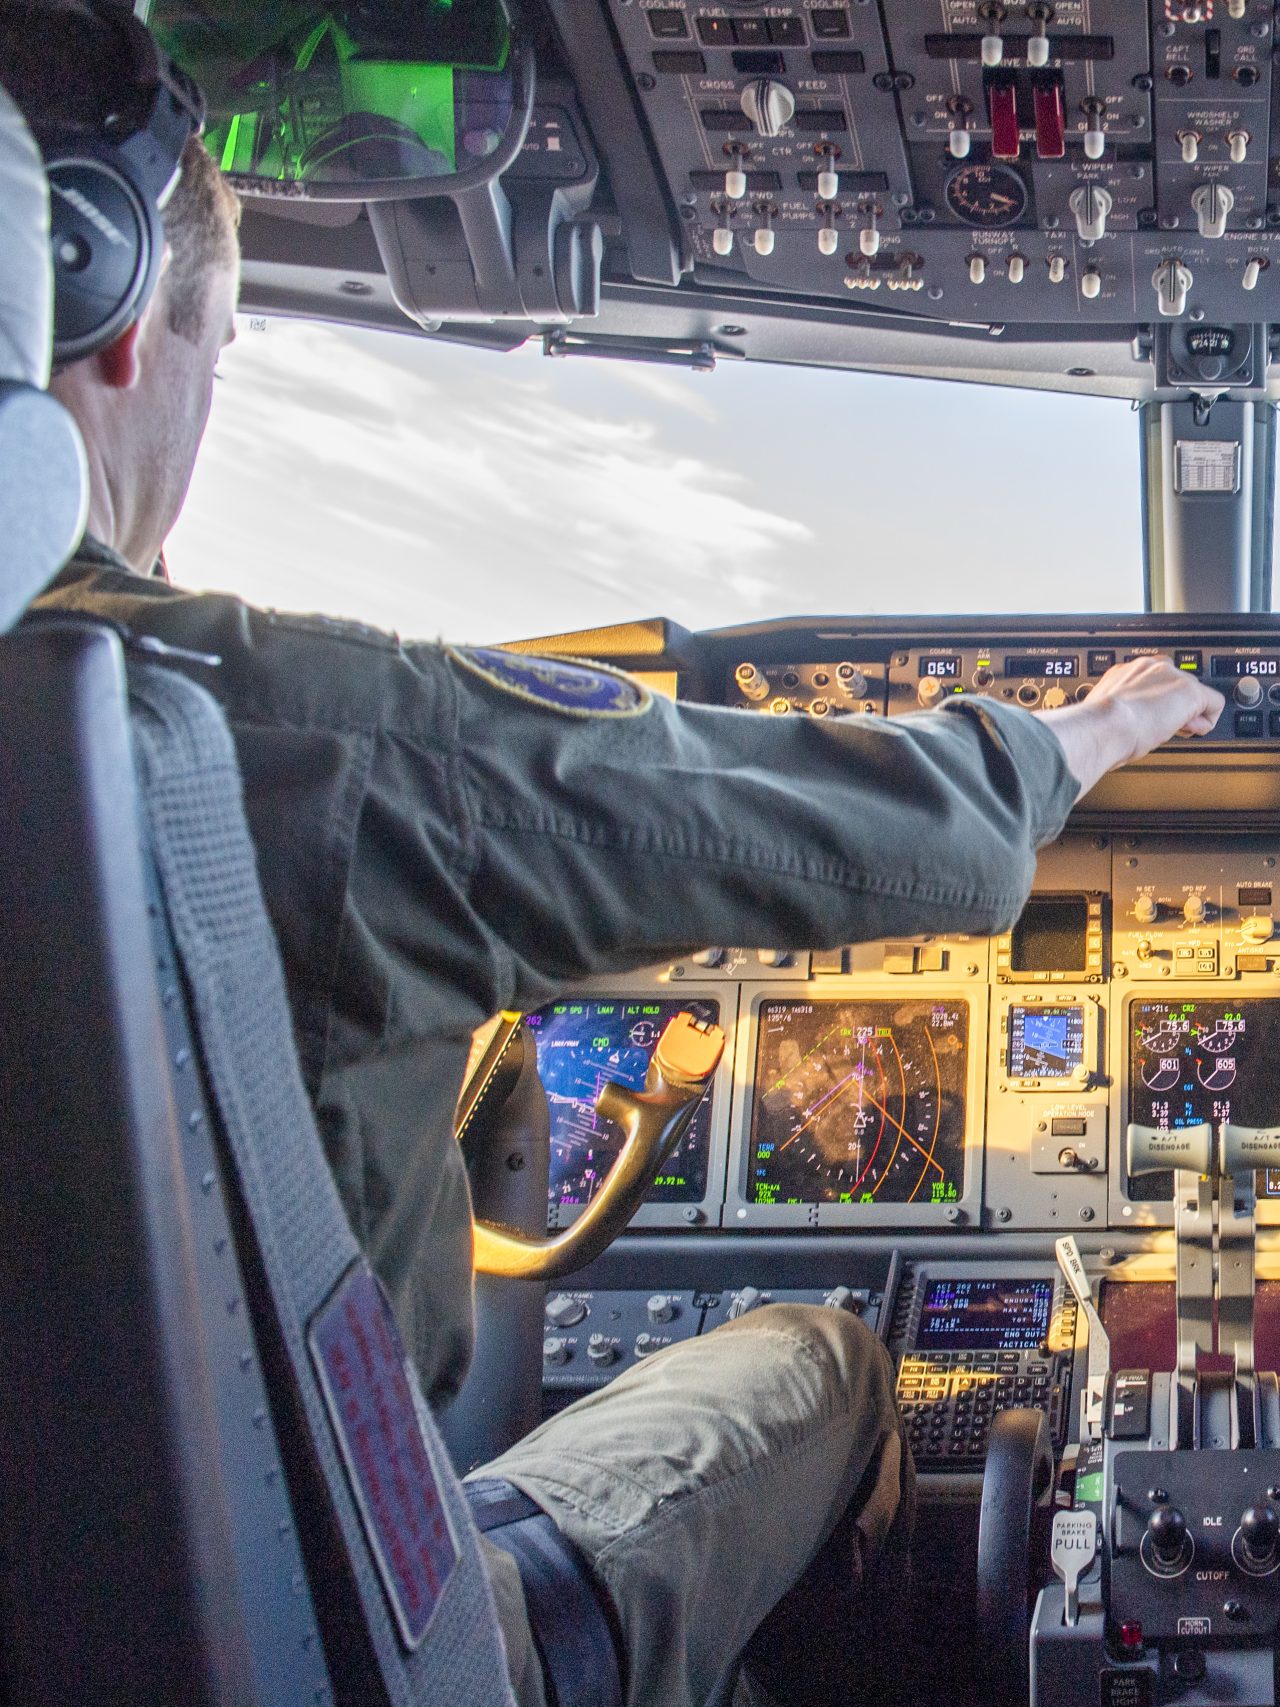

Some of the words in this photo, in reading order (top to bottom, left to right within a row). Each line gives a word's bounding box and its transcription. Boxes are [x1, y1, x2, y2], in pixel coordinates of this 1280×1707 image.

[699, 8, 728, 17] FUEL
[763, 8, 793, 17] TEMP
[952, 17, 978, 25] AUTO
[1056, 17, 1083, 25] AUTO
[1165, 45, 1191, 53] CAPT
[1233, 54, 1258, 62] CALL
[699, 81, 735, 90] CROSS
[798, 81, 827, 90] FEED
[925, 94, 944, 102] OFF
[1186, 111, 1240, 119] WINDSHIELD
[771, 148, 793, 156] CTR
[1081, 163, 1114, 171] WIPER
[927, 662, 956, 675] 064
[1045, 662, 1073, 675] 262
[1236, 661, 1278, 674] 11500
[569, 1006, 583, 1014] SPD
[597, 1006, 614, 1014] LNAV
[627, 1006, 640, 1014] ALT
[642, 1006, 660, 1014] HOLD
[1168, 1013, 1186, 1021] 92.0
[1224, 1013, 1241, 1021] 92.0
[1166, 1021, 1189, 1031] 75.6
[1222, 1021, 1244, 1031] 75.6
[856, 1027, 874, 1036] 225
[592, 1037, 610, 1047] CMD
[1160, 1060, 1178, 1069] 601
[1217, 1060, 1234, 1069] 605
[1159, 1118, 1169, 1126] 55
[1148, 1143, 1191, 1151] DISENGAGE
[932, 1182, 947, 1190] VOR
[948, 1182, 954, 1190] 2
[1062, 1241, 1074, 1256] SPD
[1069, 1259, 1082, 1274] BRK
[1202, 1517, 1223, 1526] IDLE
[1055, 1539, 1091, 1550] PULL
[1196, 1571, 1230, 1580] CUTOFF
[1180, 1626, 1208, 1634] CUTOUT
[1112, 1678, 1136, 1687] PARK
[1110, 1688, 1139, 1697] BRAKE
